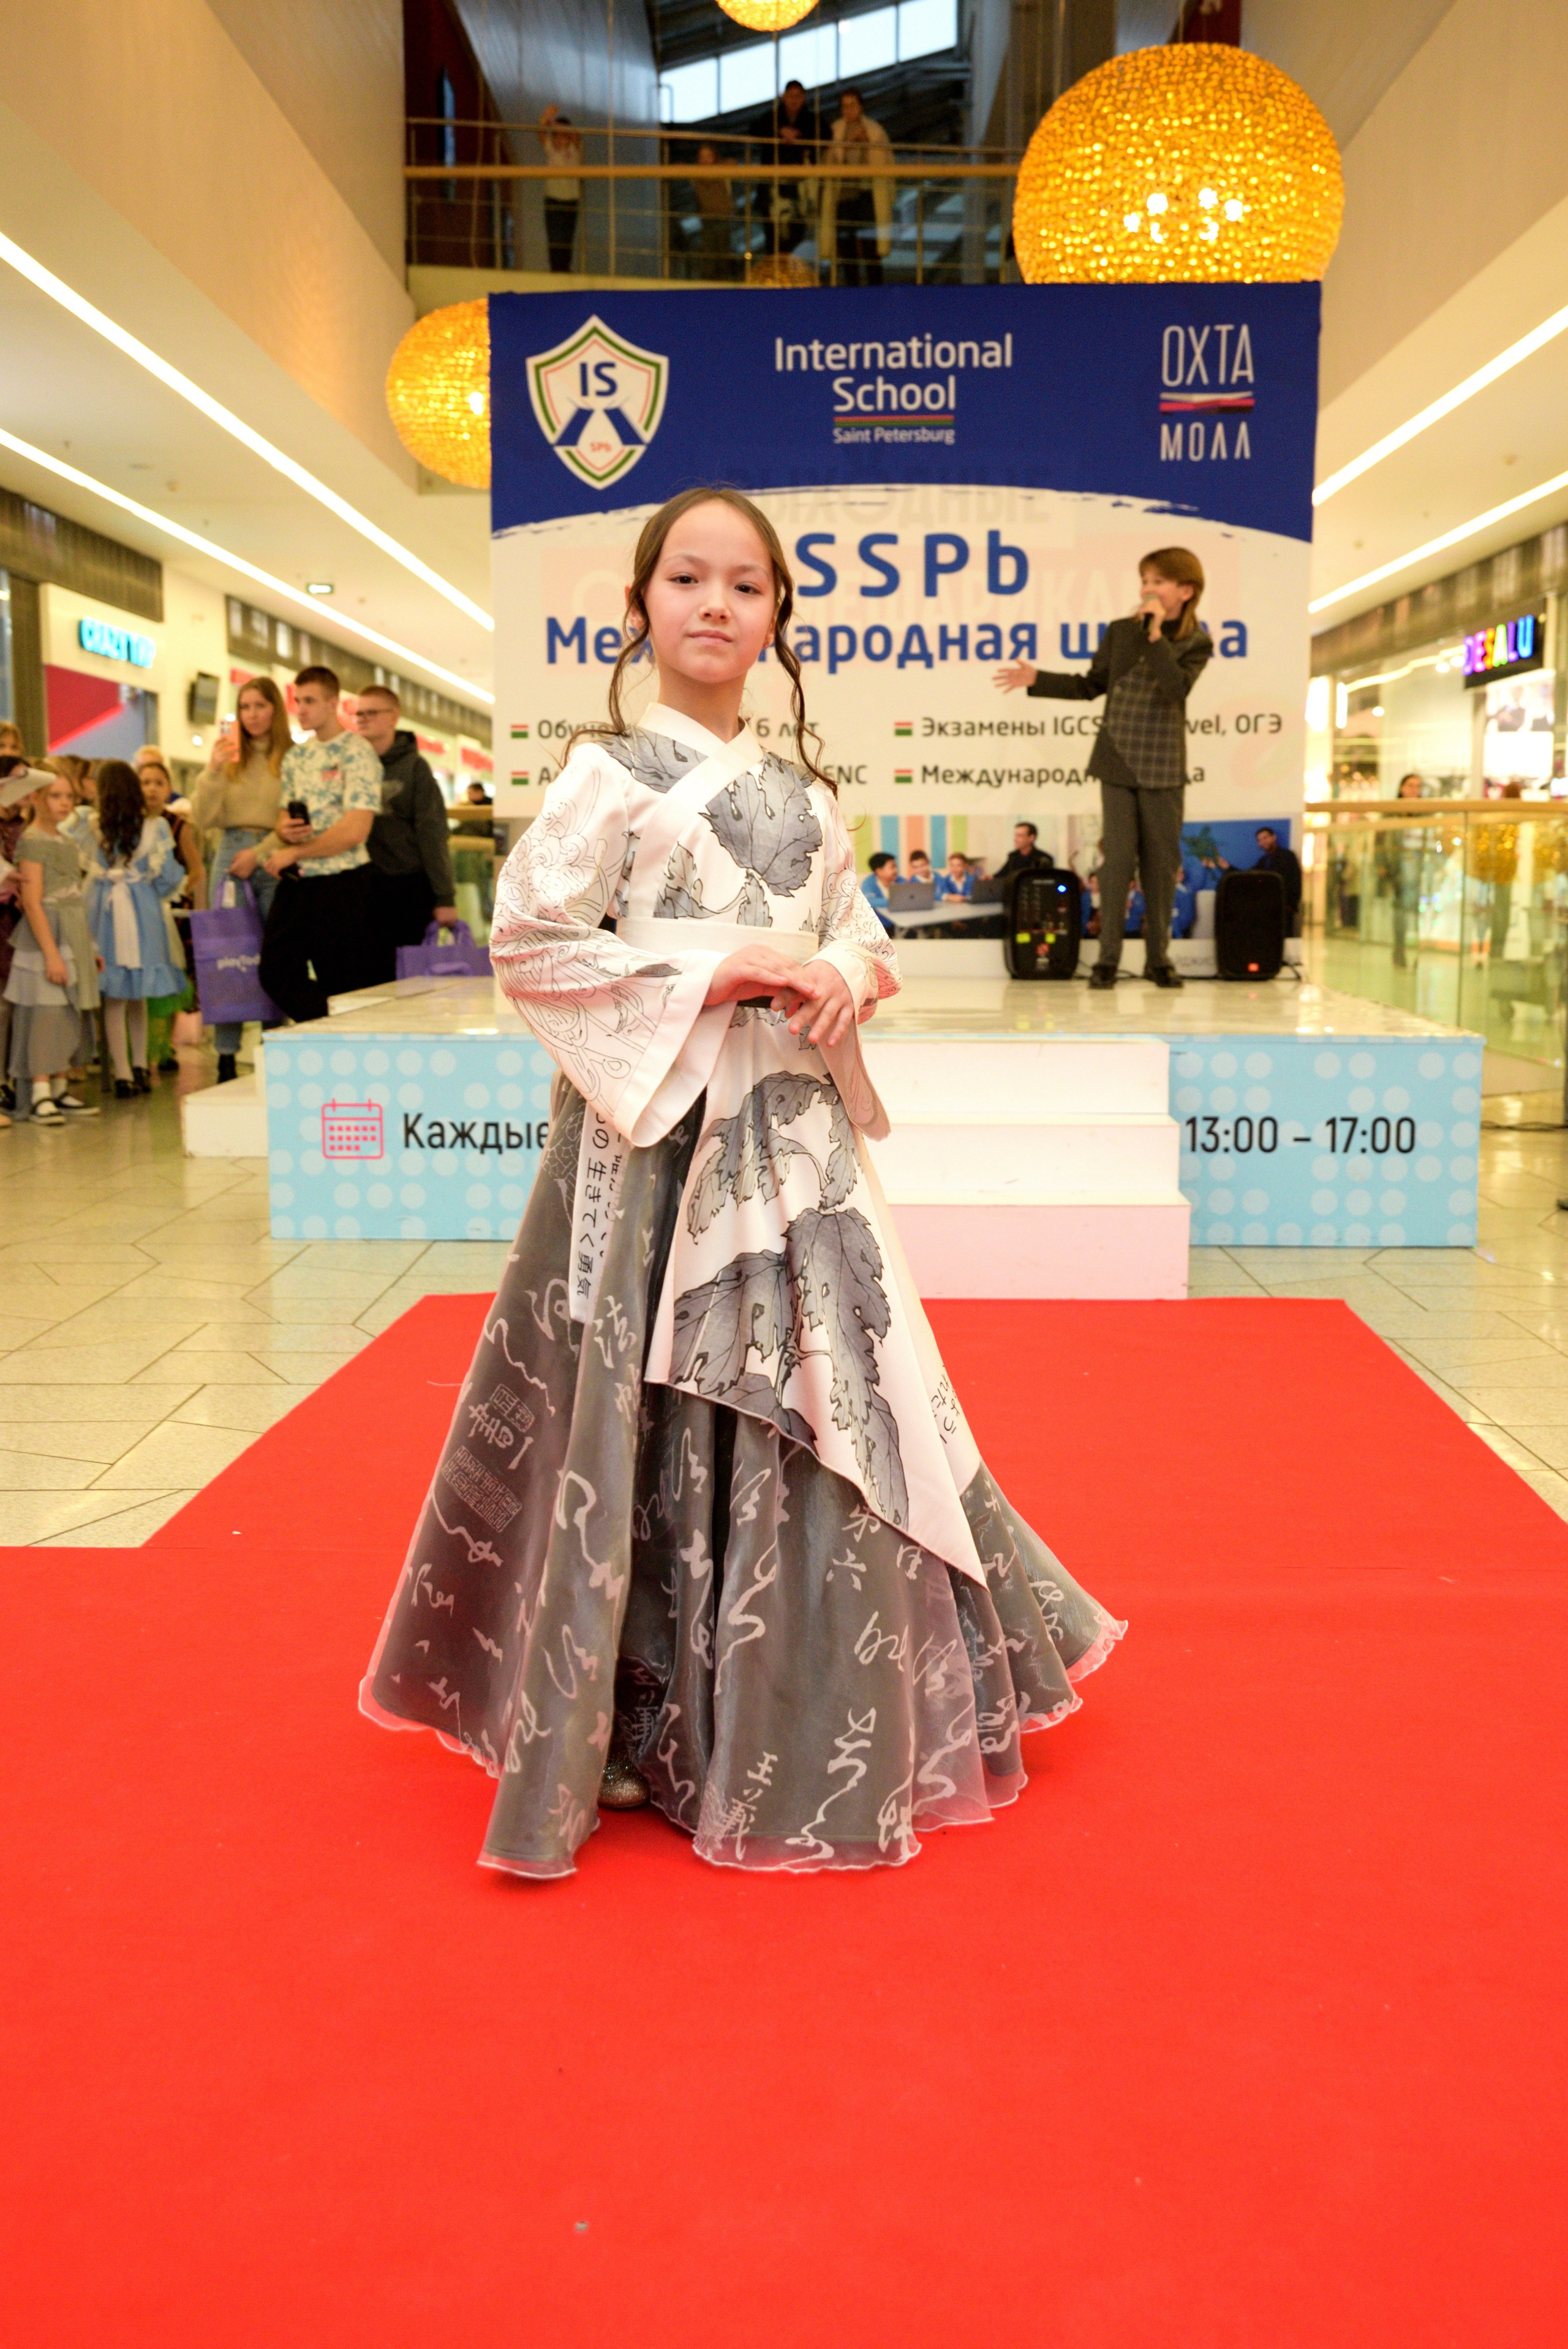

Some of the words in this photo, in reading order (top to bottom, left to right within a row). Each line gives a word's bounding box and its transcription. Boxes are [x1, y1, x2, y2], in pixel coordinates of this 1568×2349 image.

[775, 333, 1012, 371] International
[1163, 324, 1254, 387] ОХТА
[580, 361, 617, 396] IS
[832, 375, 956, 412] School
[832, 427, 870, 444] Saint
[873, 426, 956, 445] Petersburg
[794, 529, 1030, 598] SSPb
[922, 716, 1046, 736] Экзамены
[1053, 716, 1103, 736] IGCS
[1235, 714, 1283, 734] ОГЭ
[403, 1113, 549, 1154] Каждые
[1185, 1116, 1278, 1153] 13:00
[1326, 1116, 1417, 1154] 17:00
